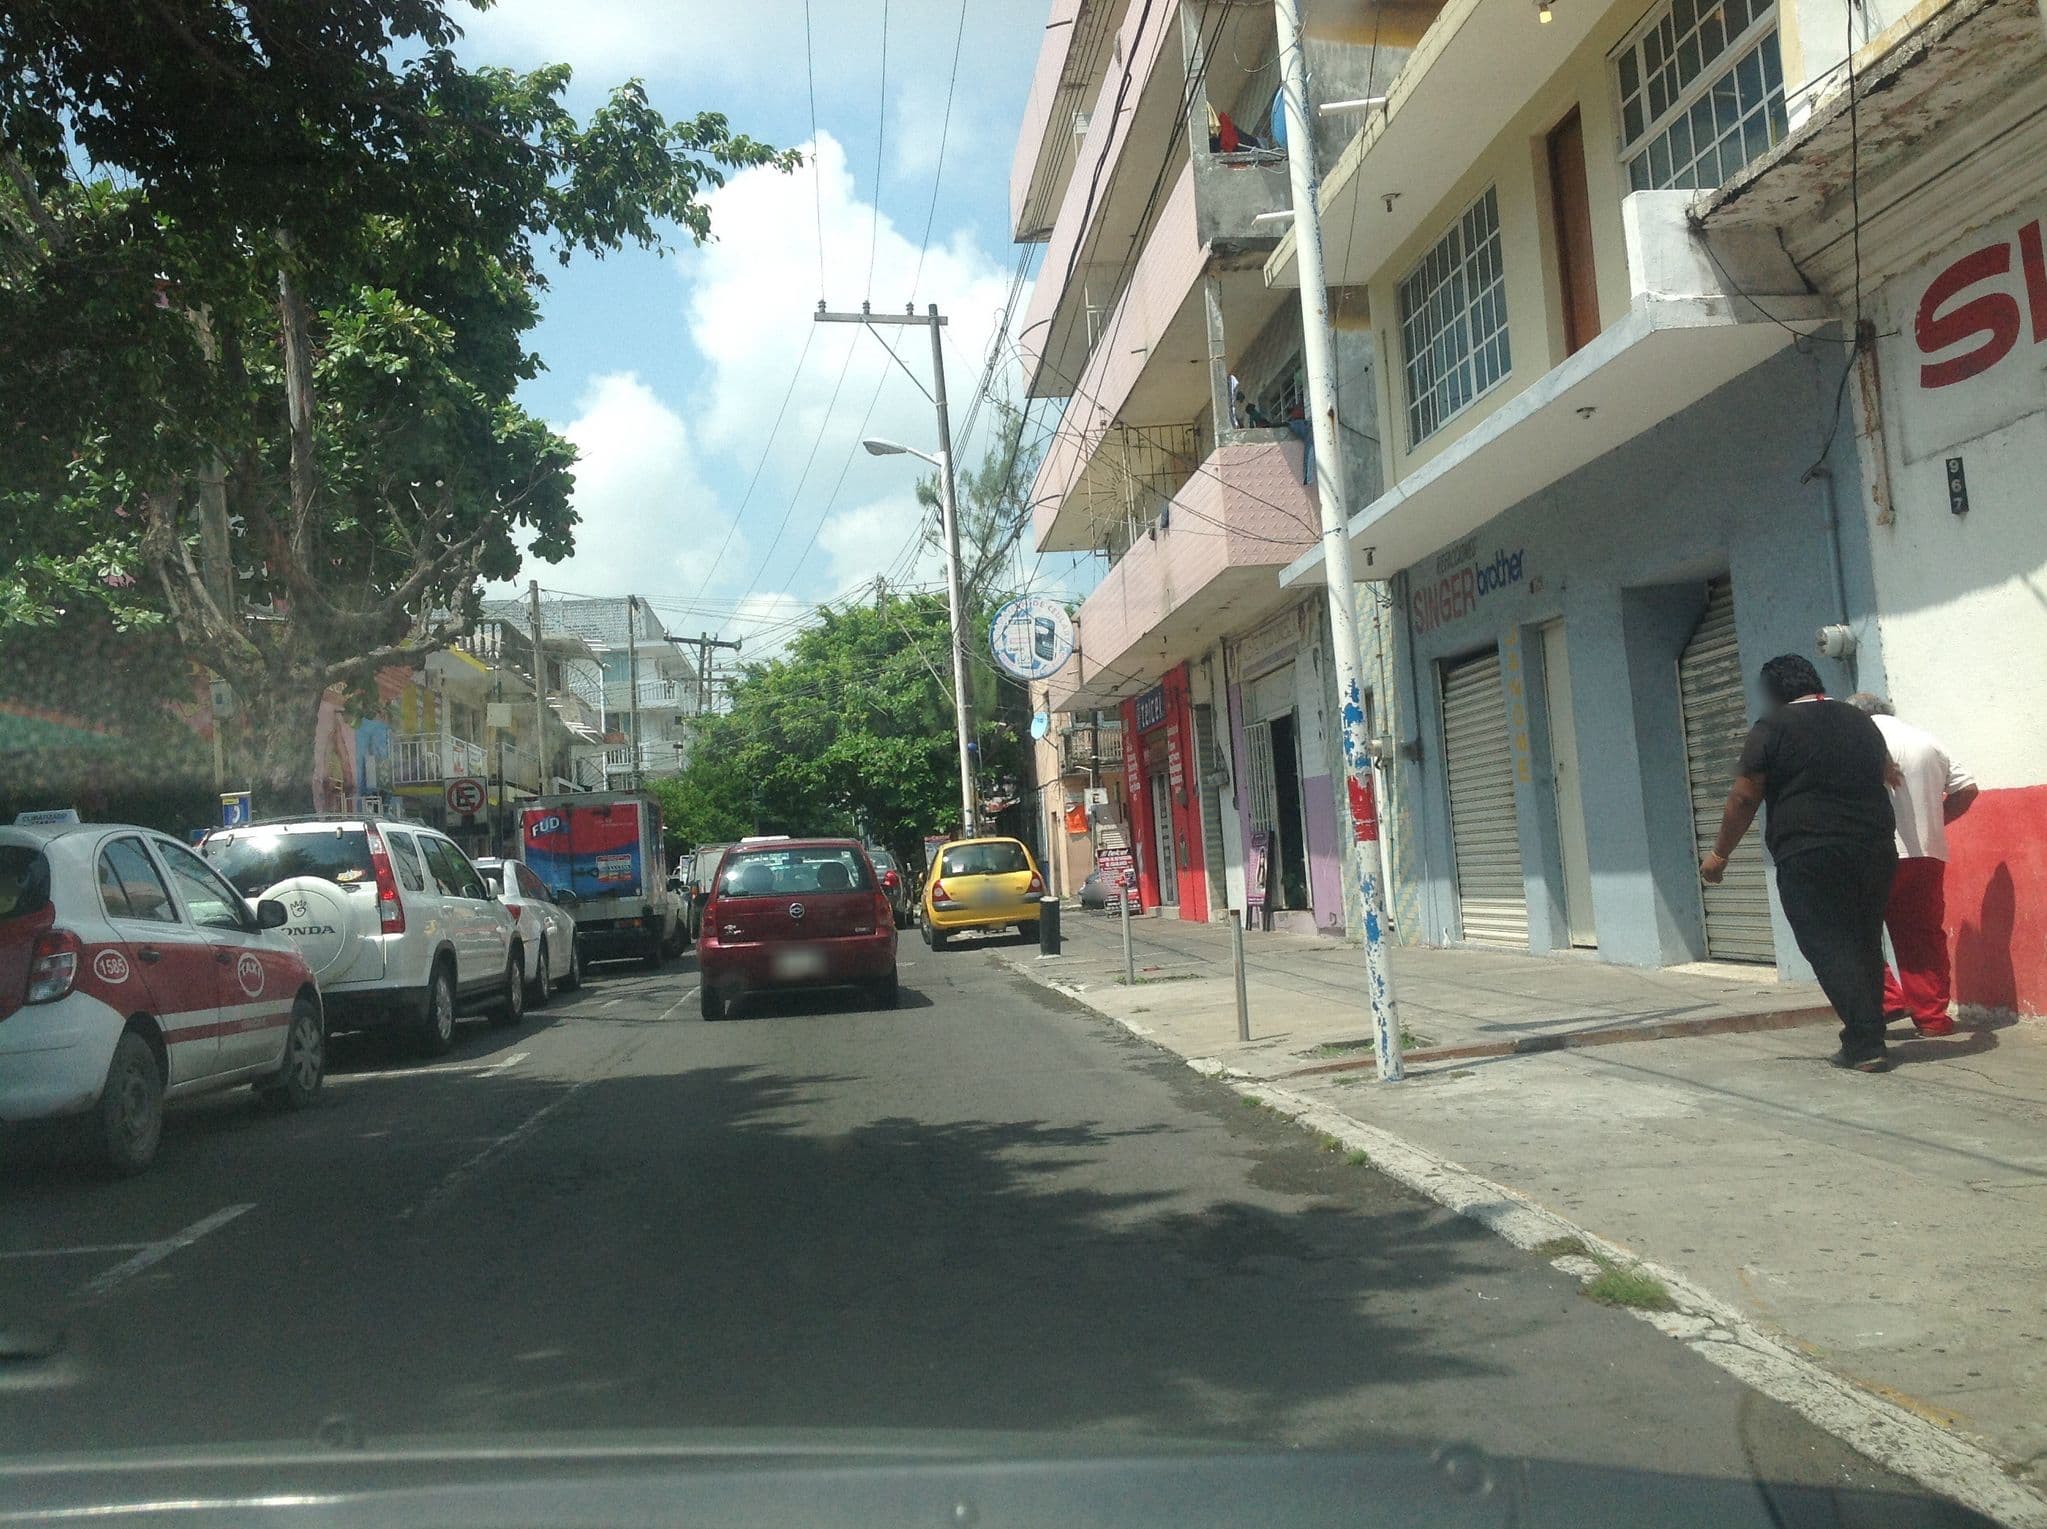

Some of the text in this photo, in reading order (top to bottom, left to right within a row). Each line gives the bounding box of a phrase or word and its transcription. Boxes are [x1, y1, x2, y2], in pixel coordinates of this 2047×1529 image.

[1948, 459, 1964, 512] 967
[1475, 549, 1525, 596] brother
[1413, 566, 1476, 635] SINGER
[532, 816, 560, 837] FUD
[280, 925, 336, 936] ONDA
[99, 958, 126, 976] 1585
[239, 961, 262, 978] TAXI
